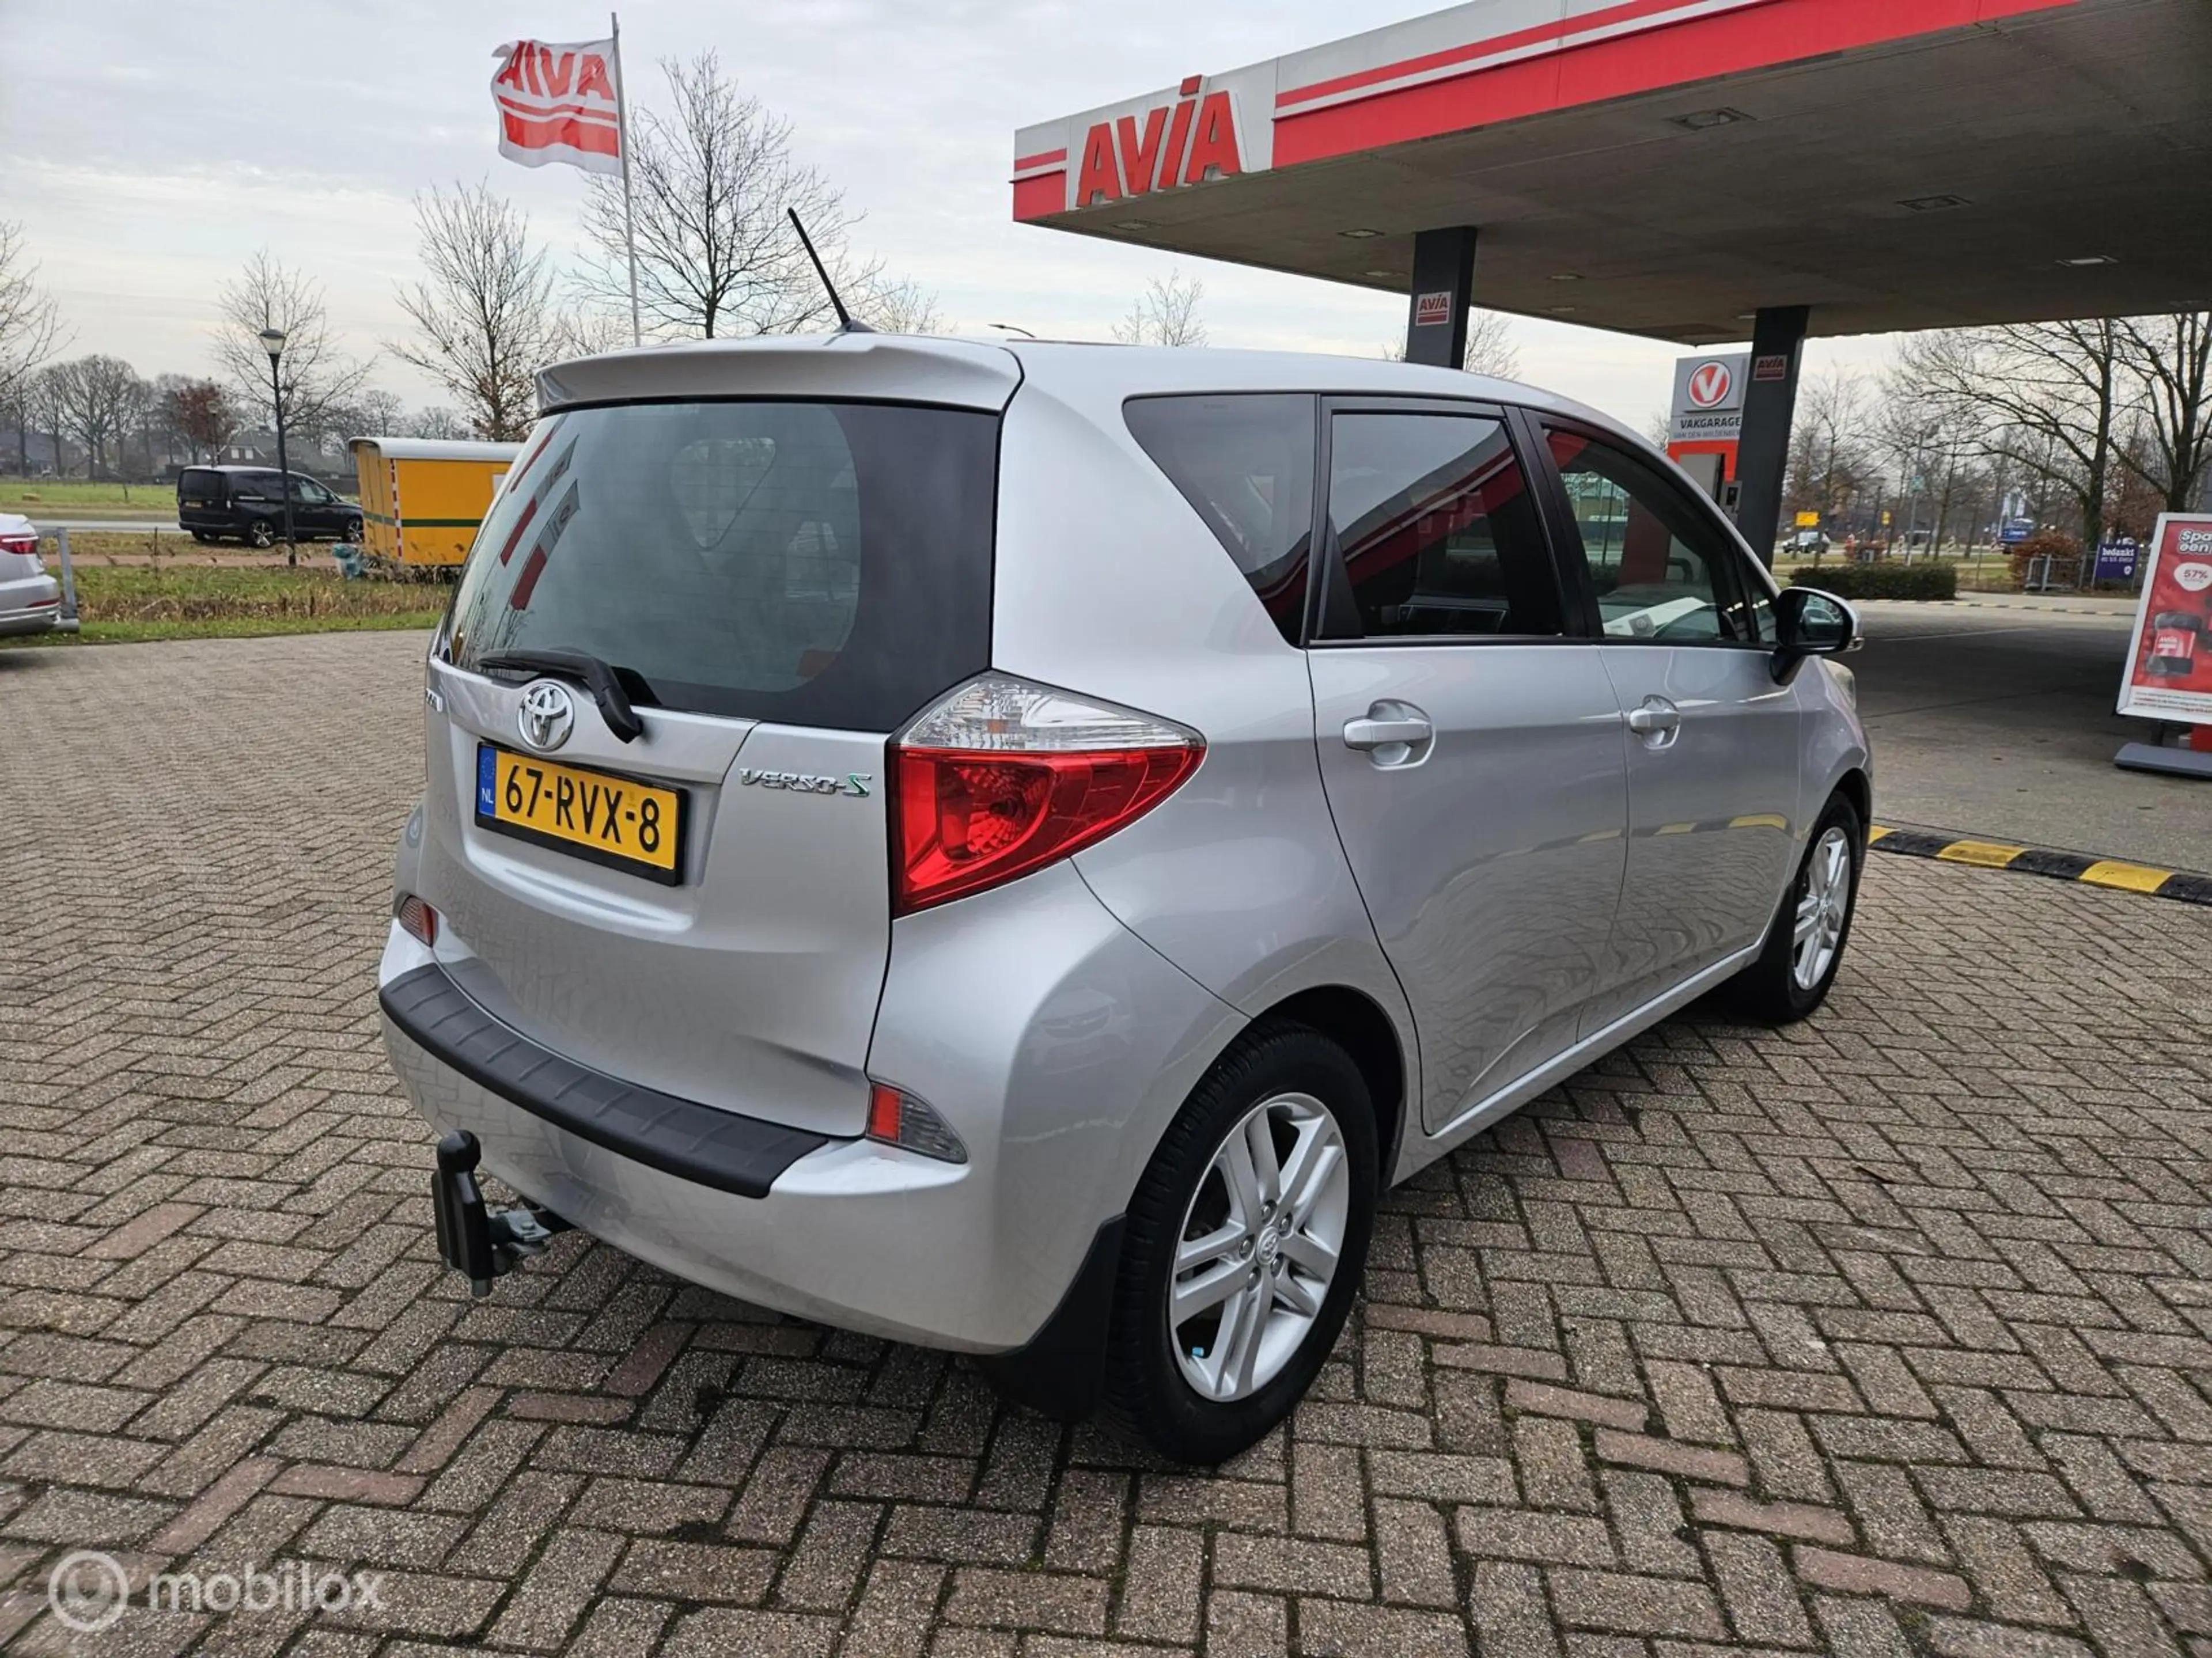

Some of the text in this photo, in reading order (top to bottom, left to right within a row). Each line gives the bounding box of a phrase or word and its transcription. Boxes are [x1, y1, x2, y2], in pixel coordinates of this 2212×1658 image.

[1680, 417, 1741, 428] VAKGARAGE
[740, 768, 872, 797] VERSO-S
[482, 788, 494, 804] NL
[506, 765, 660, 853] 67-RVX-8
